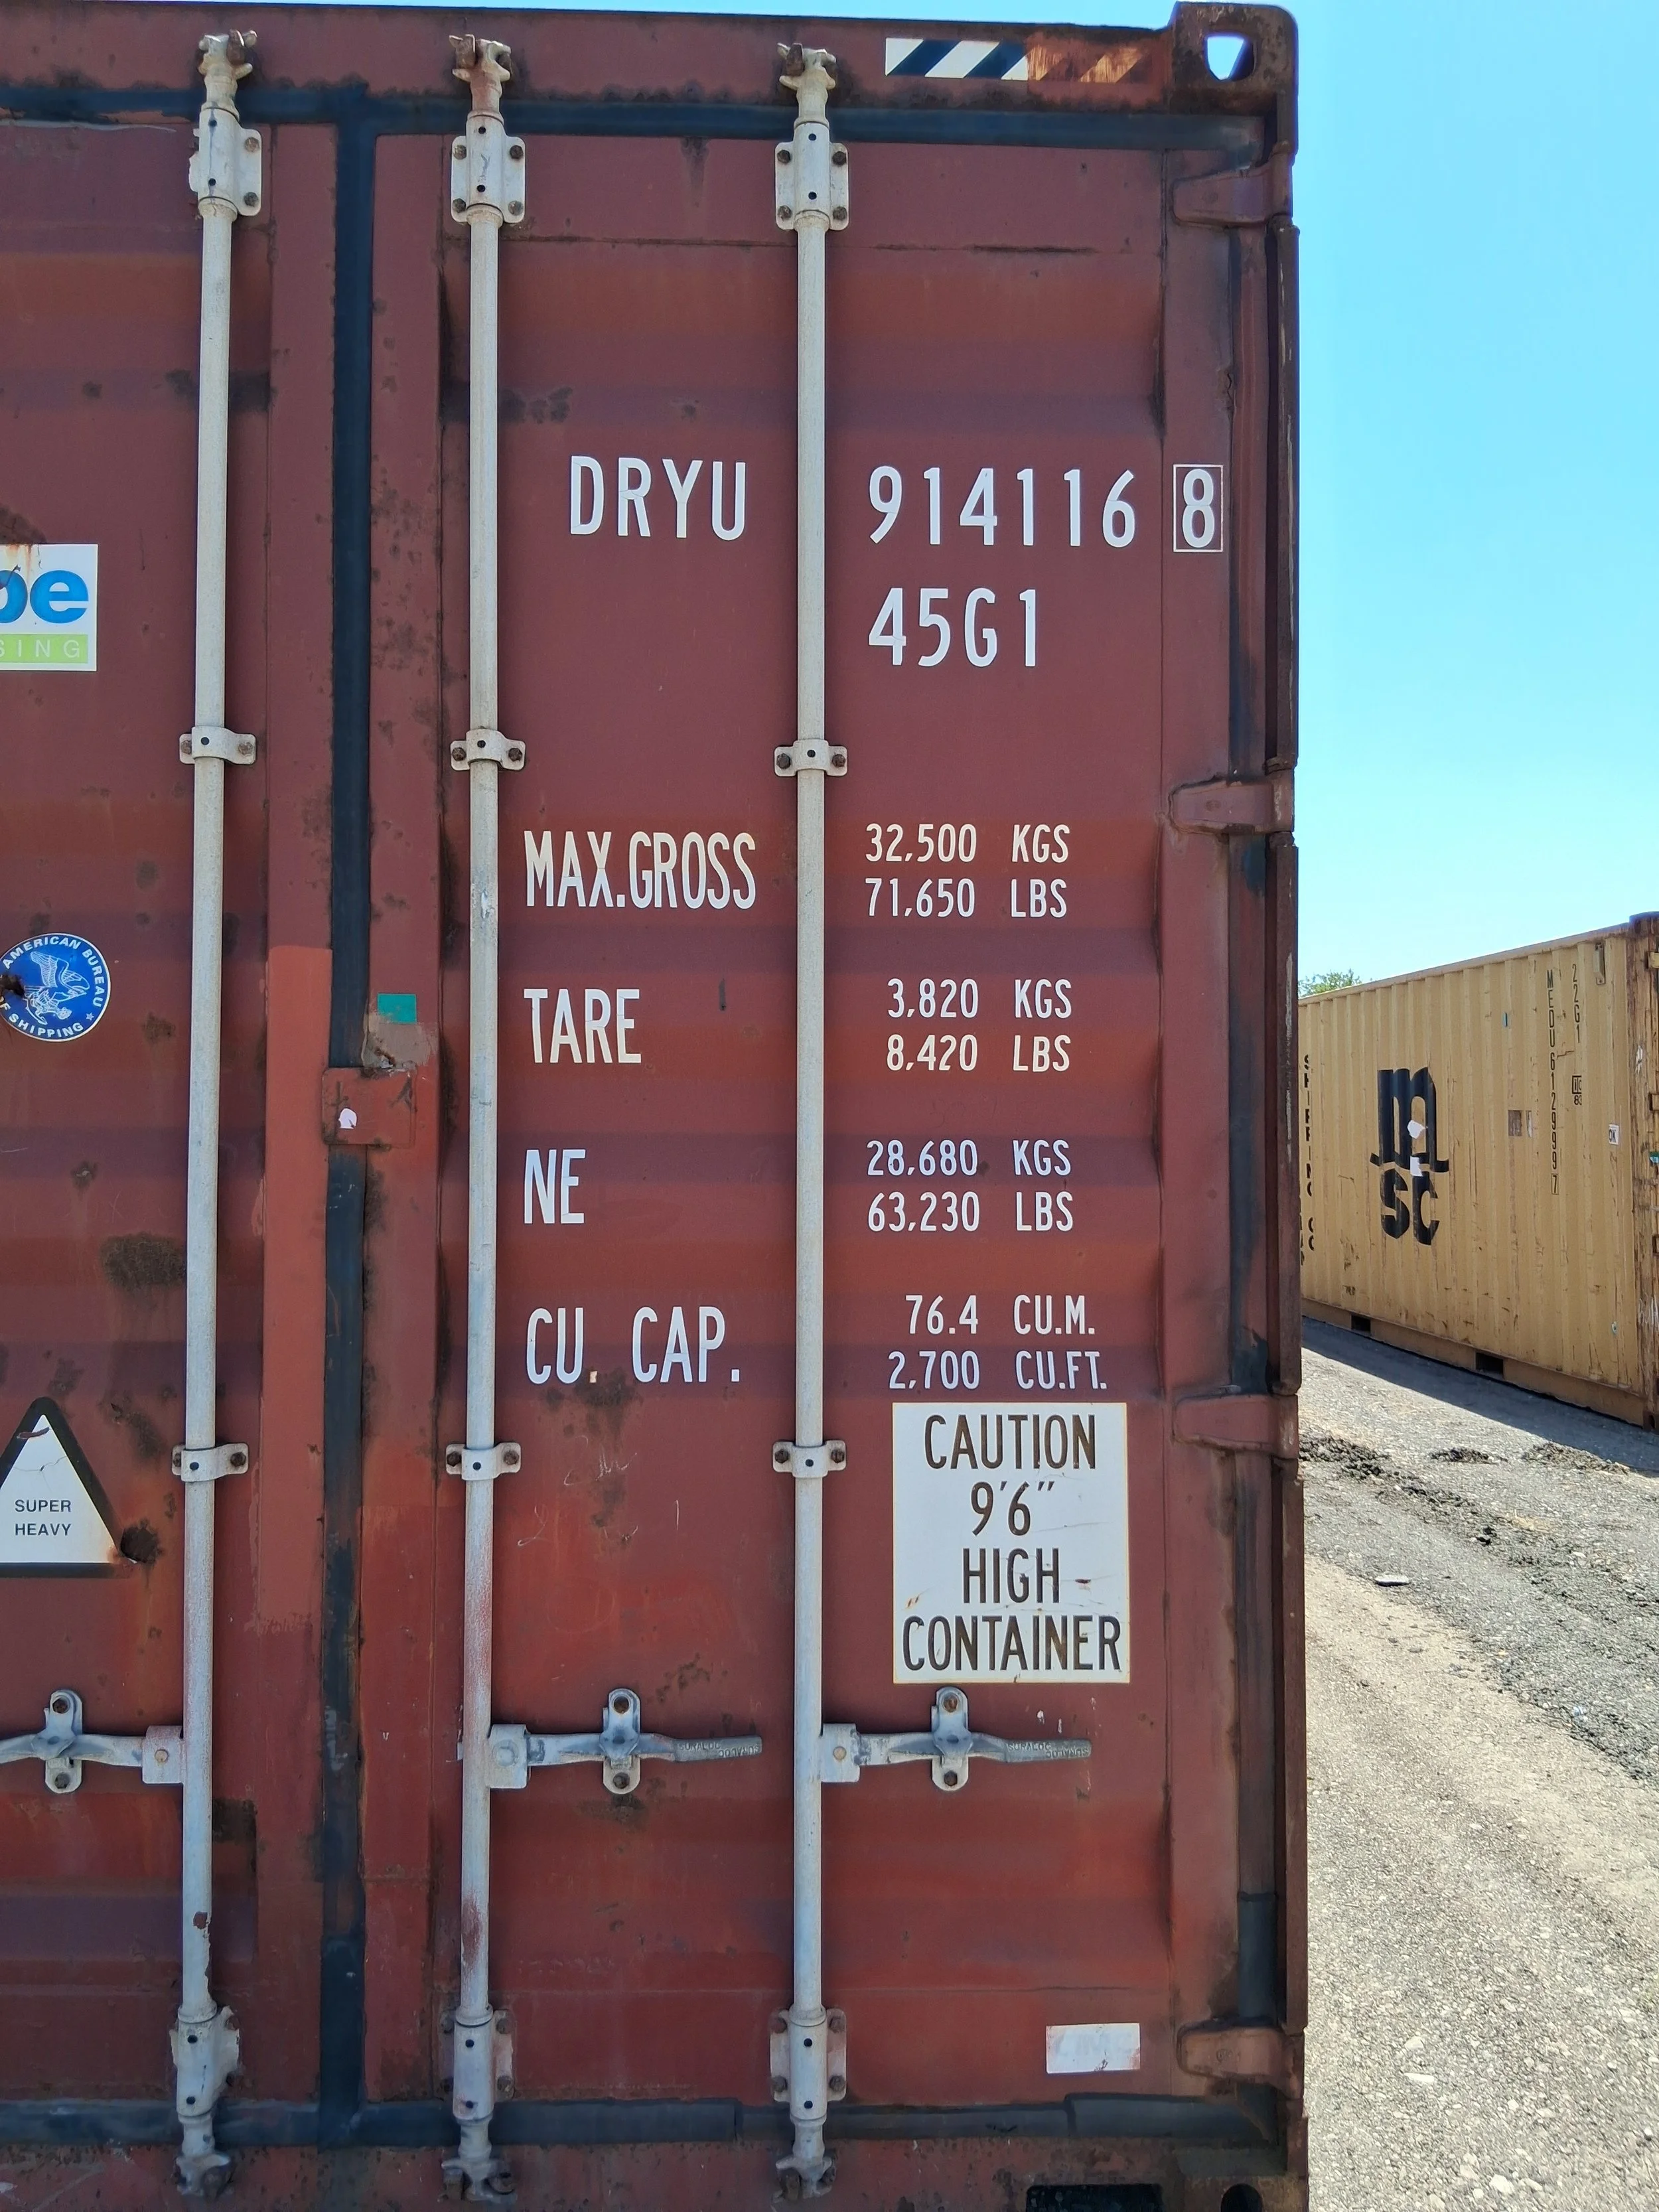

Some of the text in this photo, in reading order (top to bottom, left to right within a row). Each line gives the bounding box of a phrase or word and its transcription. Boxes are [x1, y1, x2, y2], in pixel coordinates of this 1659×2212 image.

[571, 456, 1215, 548] DRYU 914116 8
[869, 588, 1035, 667] 45G1
[866, 824, 1070, 863] 32,500 KGS
[524, 831, 755, 909] MAX.GROSS
[866, 878, 1066, 917] 71,650 LBS
[2, 936, 81, 969] AMERICAN
[82, 949, 105, 1007] BUREAU
[888, 978, 1071, 1018] 3,820 KGS
[9, 1013, 84, 1037] SHIPPING
[524, 989, 641, 1063] TARE
[1547, 970, 1555, 1047] MEDU
[1571, 964, 1581, 1043] 22G1
[887, 1035, 1070, 1072] 8,420 LBS
[867, 1140, 1070, 1175] 28,680 KGS
[525, 1149, 585, 1223] NE
[869, 1191, 1072, 1231] 63,230 LBS
[906, 1295, 1094, 1334] 76.4 CU.M.
[632, 1307, 739, 1382] CAP.
[889, 1351, 1106, 1389] 2,700 CU.FT.
[925, 1415, 1095, 1469] CAUTION
[15, 1499, 70, 1512] SUPER
[15, 1524, 70, 1535] HEAVY
[964, 1548, 1059, 1603] HIGH
[903, 1616, 1120, 1670] CONTAINER
